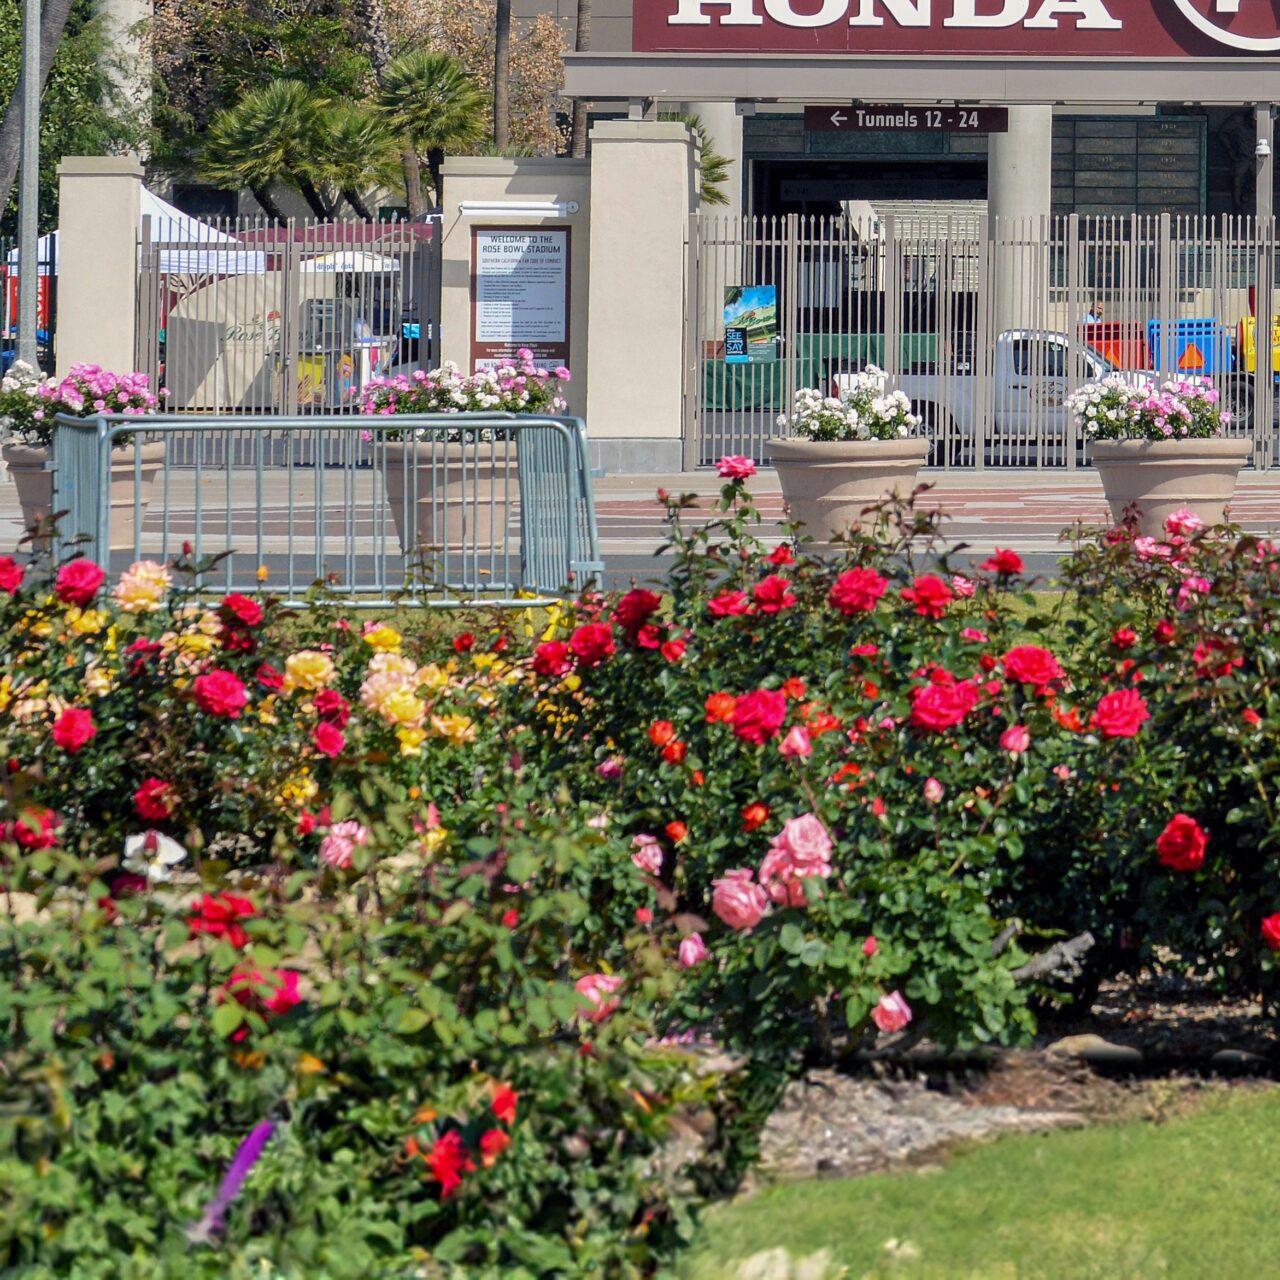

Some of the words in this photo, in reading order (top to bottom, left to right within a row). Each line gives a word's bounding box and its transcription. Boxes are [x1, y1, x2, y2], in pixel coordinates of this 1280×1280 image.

[856, 110, 918, 127] Tunnels
[925, 110, 942, 127] 12
[959, 111, 979, 128] 24
[482, 245, 501, 253] ROSE
[503, 245, 524, 253] BOWL
[527, 245, 561, 253] STADIUM
